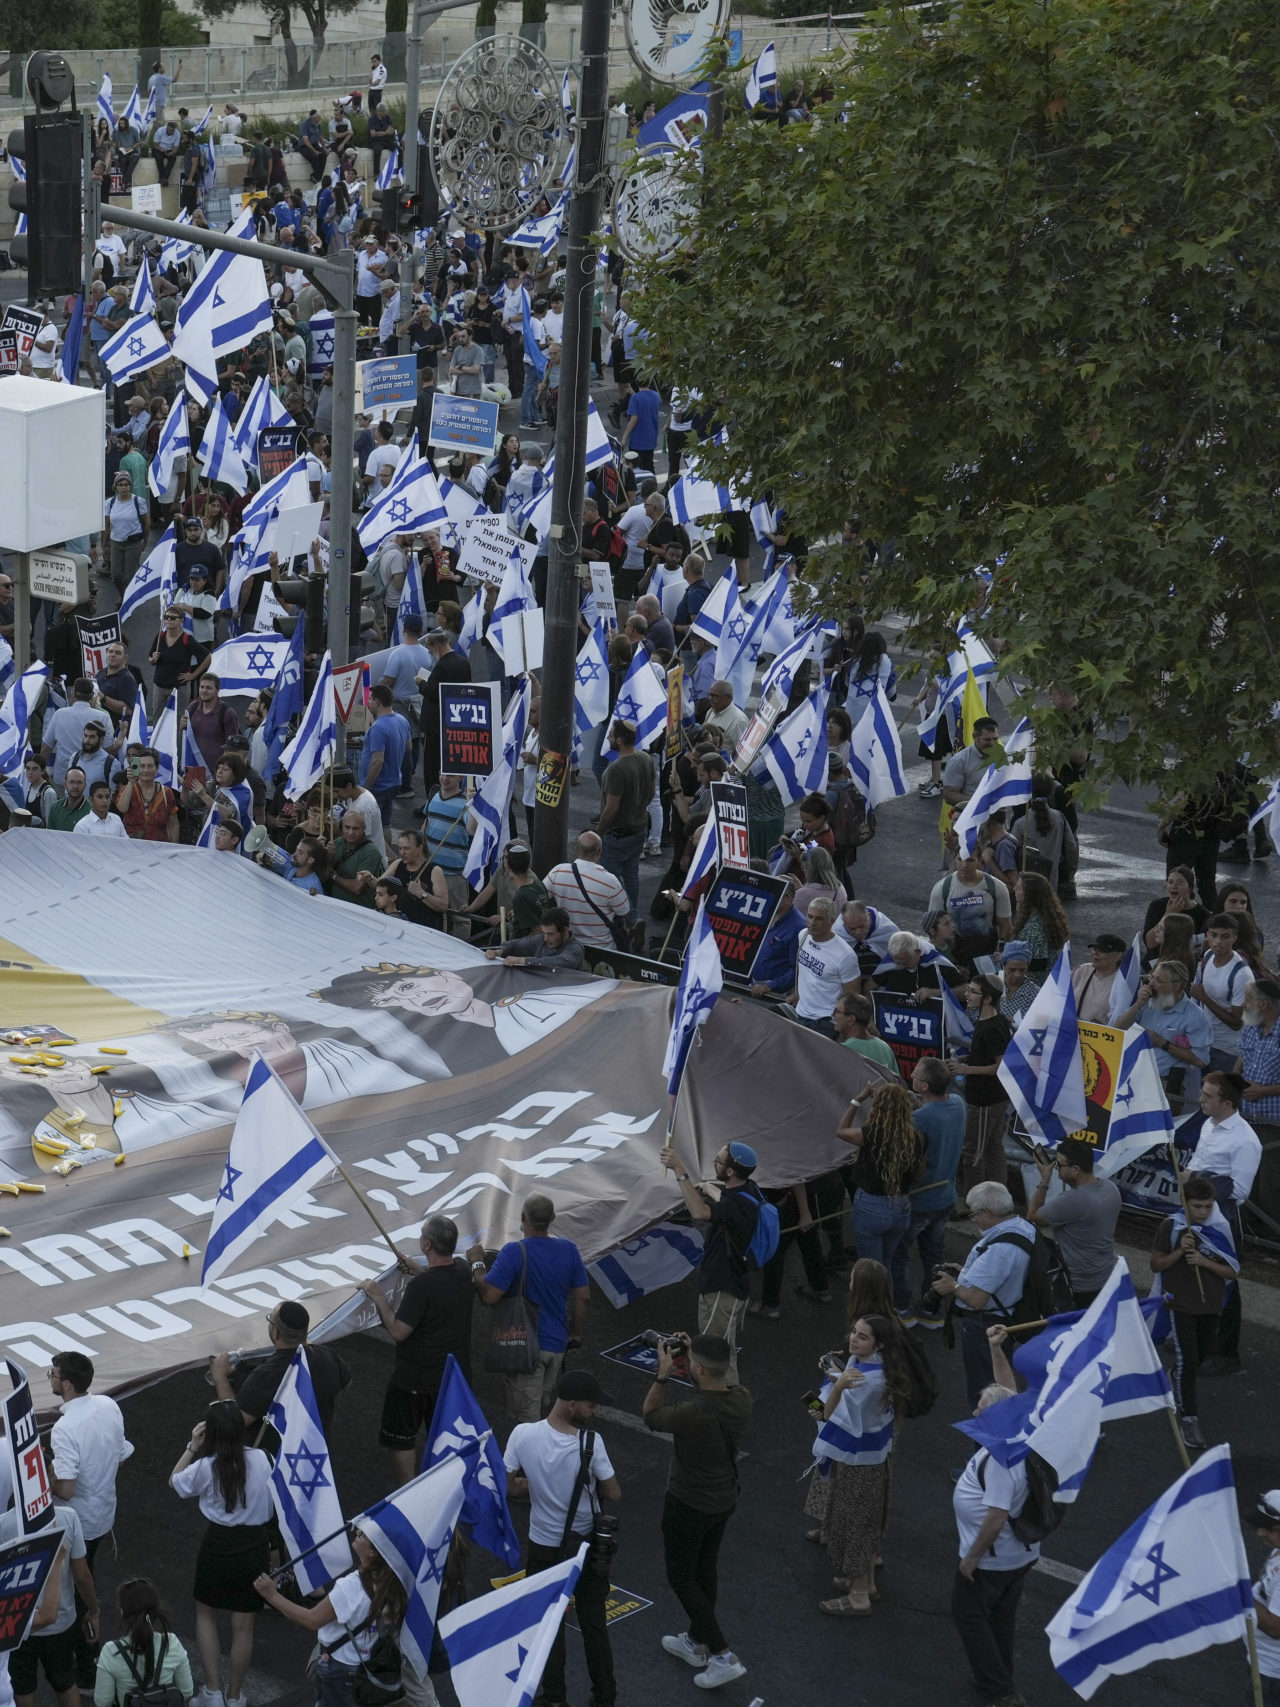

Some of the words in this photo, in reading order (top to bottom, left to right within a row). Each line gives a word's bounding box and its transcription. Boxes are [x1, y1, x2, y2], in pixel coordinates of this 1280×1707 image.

[81, 627, 117, 646] נבצרות
[449, 704, 487, 725] בג״צ
[446, 728, 477, 743] תפסול
[480, 731, 490, 744] לא
[449, 744, 488, 765] אותי!
[717, 800, 746, 823] נבצרות
[715, 887, 767, 919] בג״צ
[741, 925, 761, 941] לא
[714, 933, 753, 961] אות
[884, 1012, 933, 1041] בג״צ
[1078, 1027, 1099, 1039] בהר
[1102, 1032, 1115, 1043] גלי
[499, 1109, 662, 1179] את
[11, 1593, 34, 1611] לא
